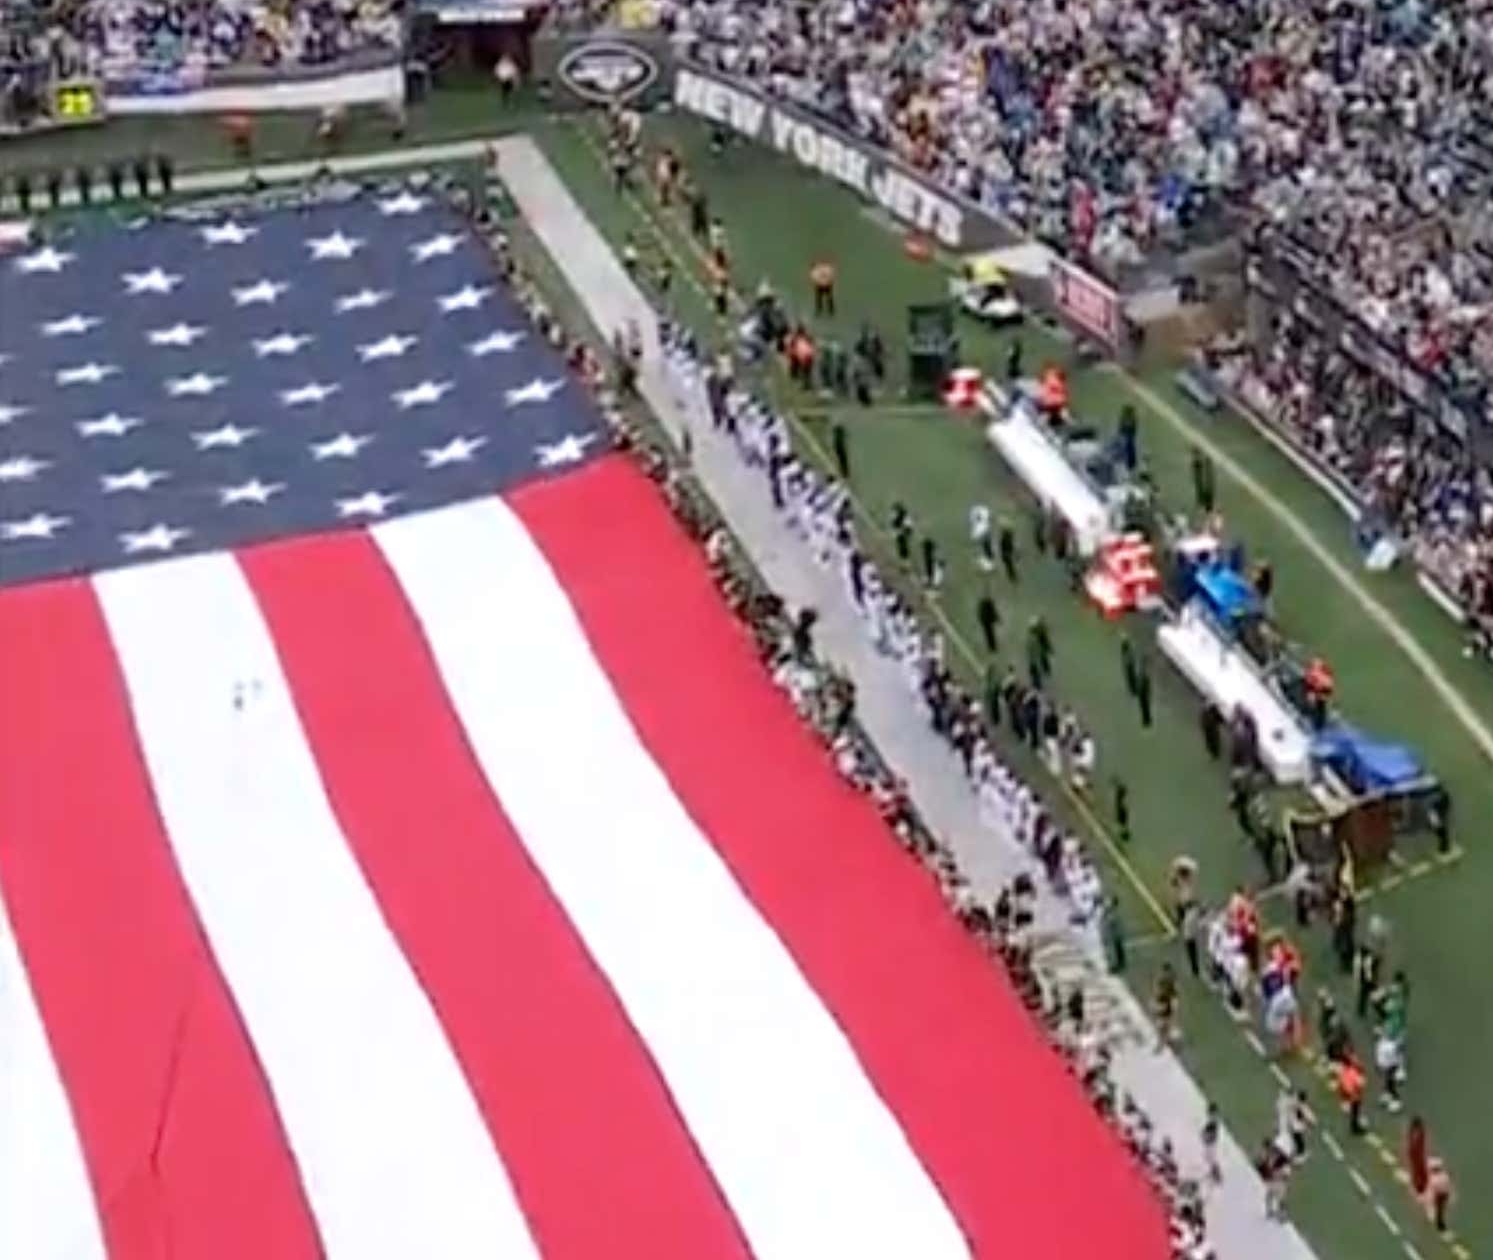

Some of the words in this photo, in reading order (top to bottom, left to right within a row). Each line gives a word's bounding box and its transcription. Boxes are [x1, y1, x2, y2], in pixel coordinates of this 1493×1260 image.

[673, 68, 765, 137] NEW
[770, 105, 870, 198] YORK
[870, 166, 963, 246] JETS
